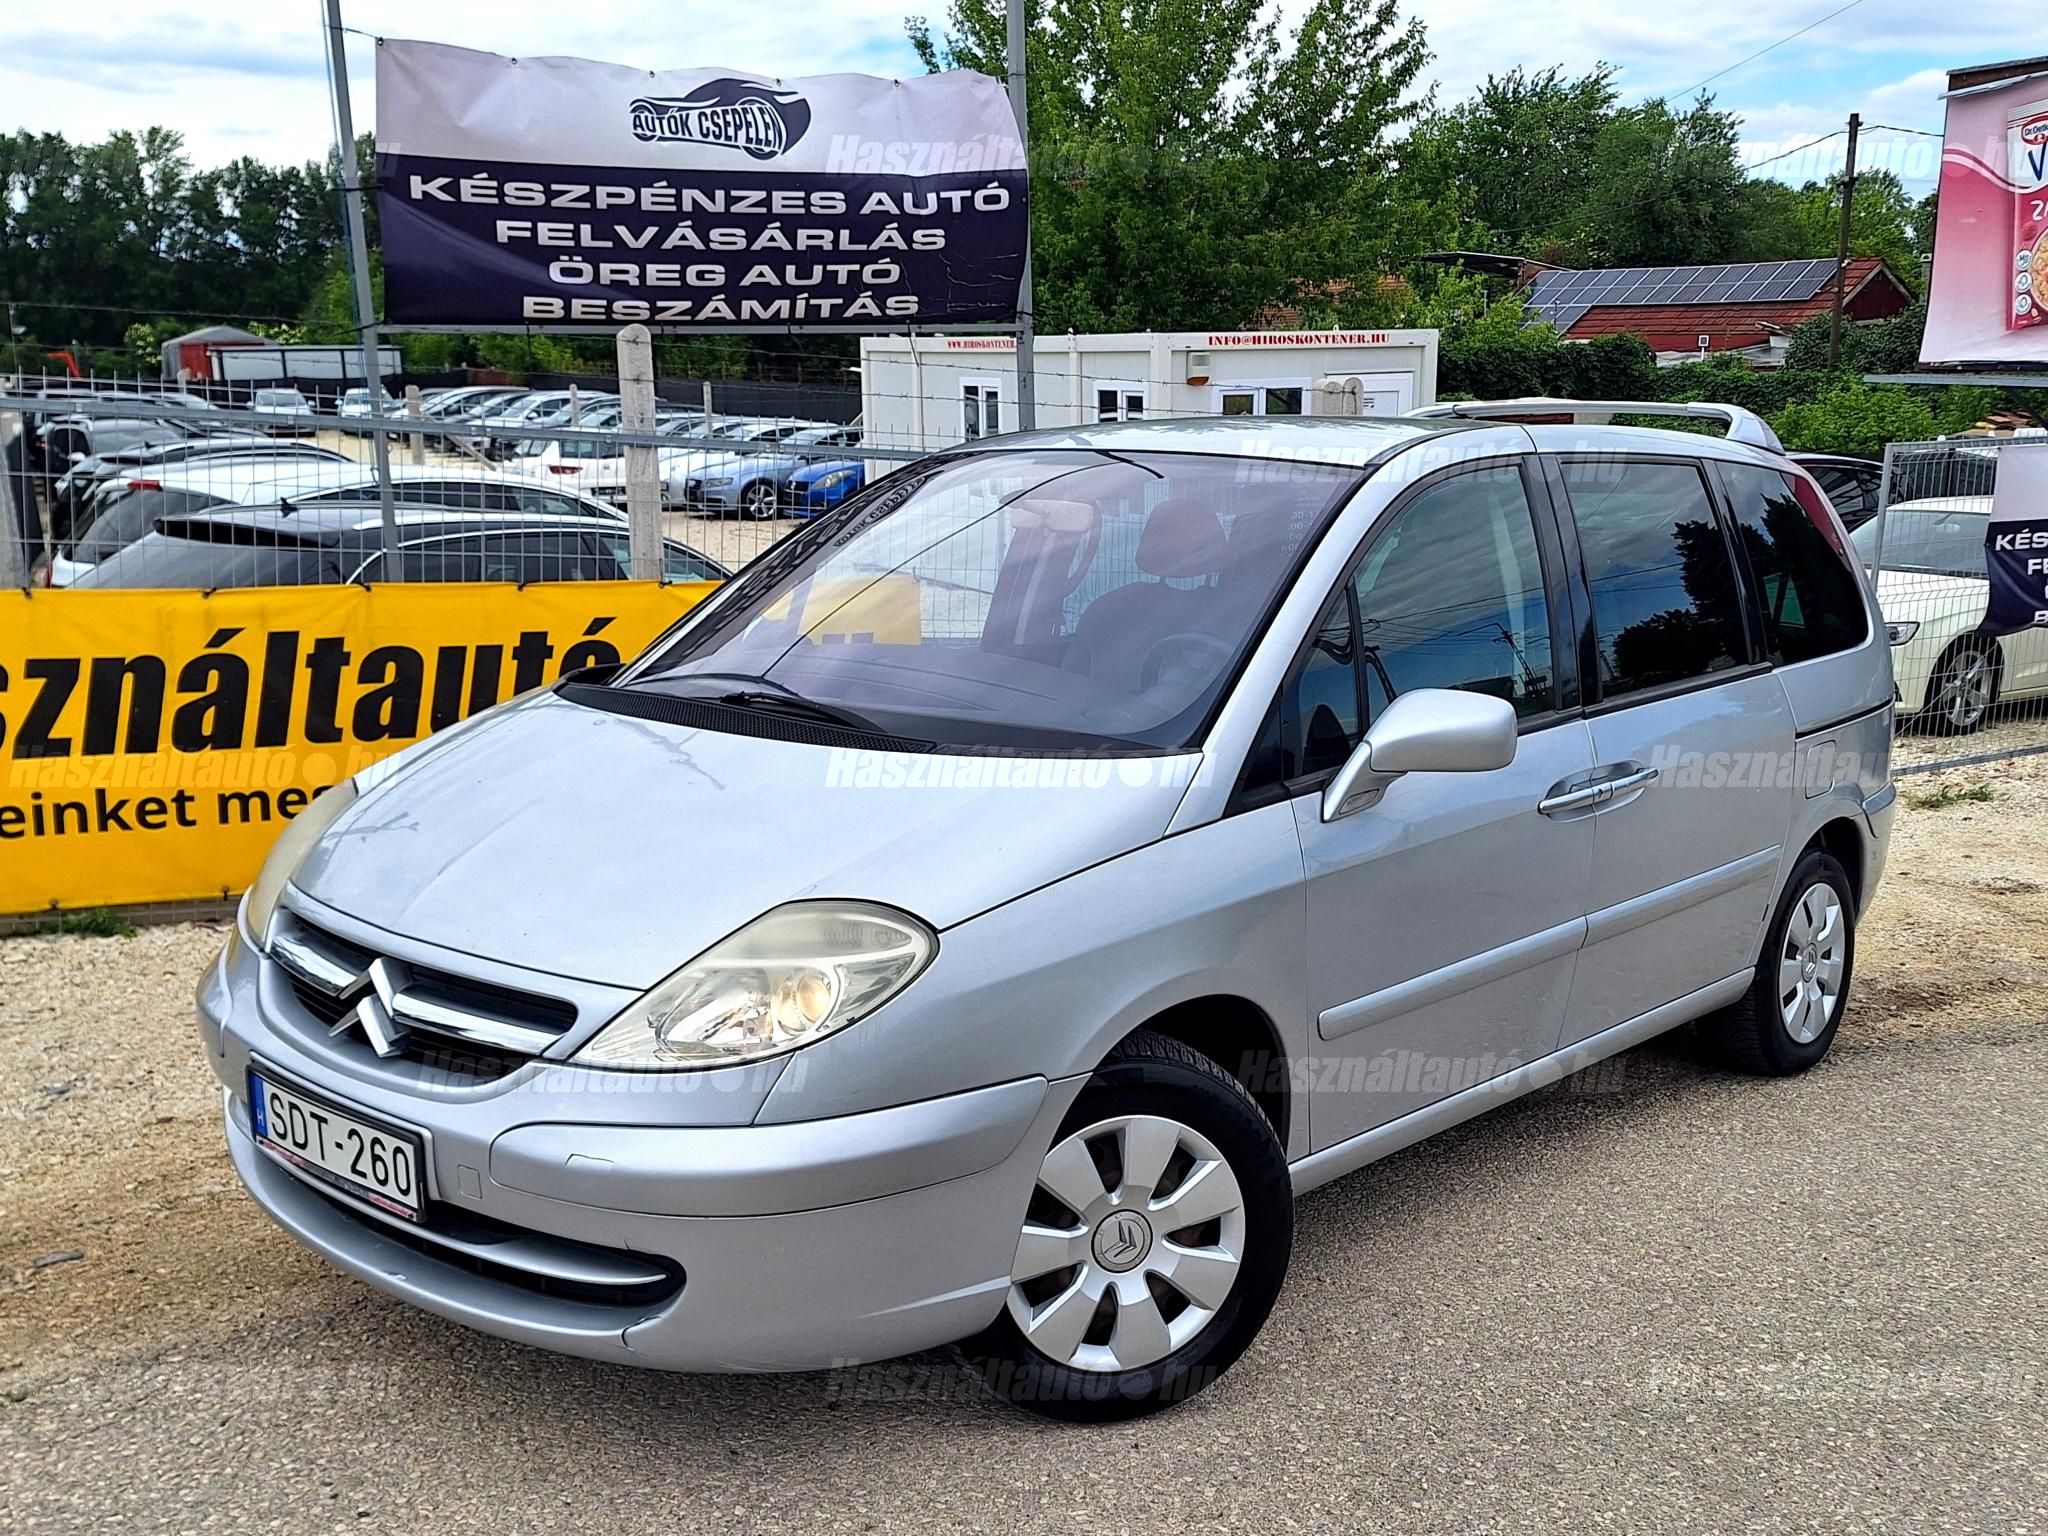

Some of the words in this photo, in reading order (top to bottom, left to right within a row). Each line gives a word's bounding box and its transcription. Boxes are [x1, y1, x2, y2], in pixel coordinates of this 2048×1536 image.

[633, 107, 693, 137] AUTÓK
[697, 105, 782, 150] CSEPELEN
[409, 171, 847, 214] KÉSZPÉNZES
[859, 170, 1010, 216] AUTÓ
[496, 219, 946, 252] FELVÁSÁRLÁS
[548, 255, 726, 288] ÖREG
[739, 257, 901, 288] AUTÓ
[522, 292, 919, 322] BESZÁMÍTÁS
[1208, 333, 1391, 346] INFO@HIROSKONTENER.HU
[0, 617, 621, 760] ználtautó
[269, 1092, 411, 1197] SDT-260
